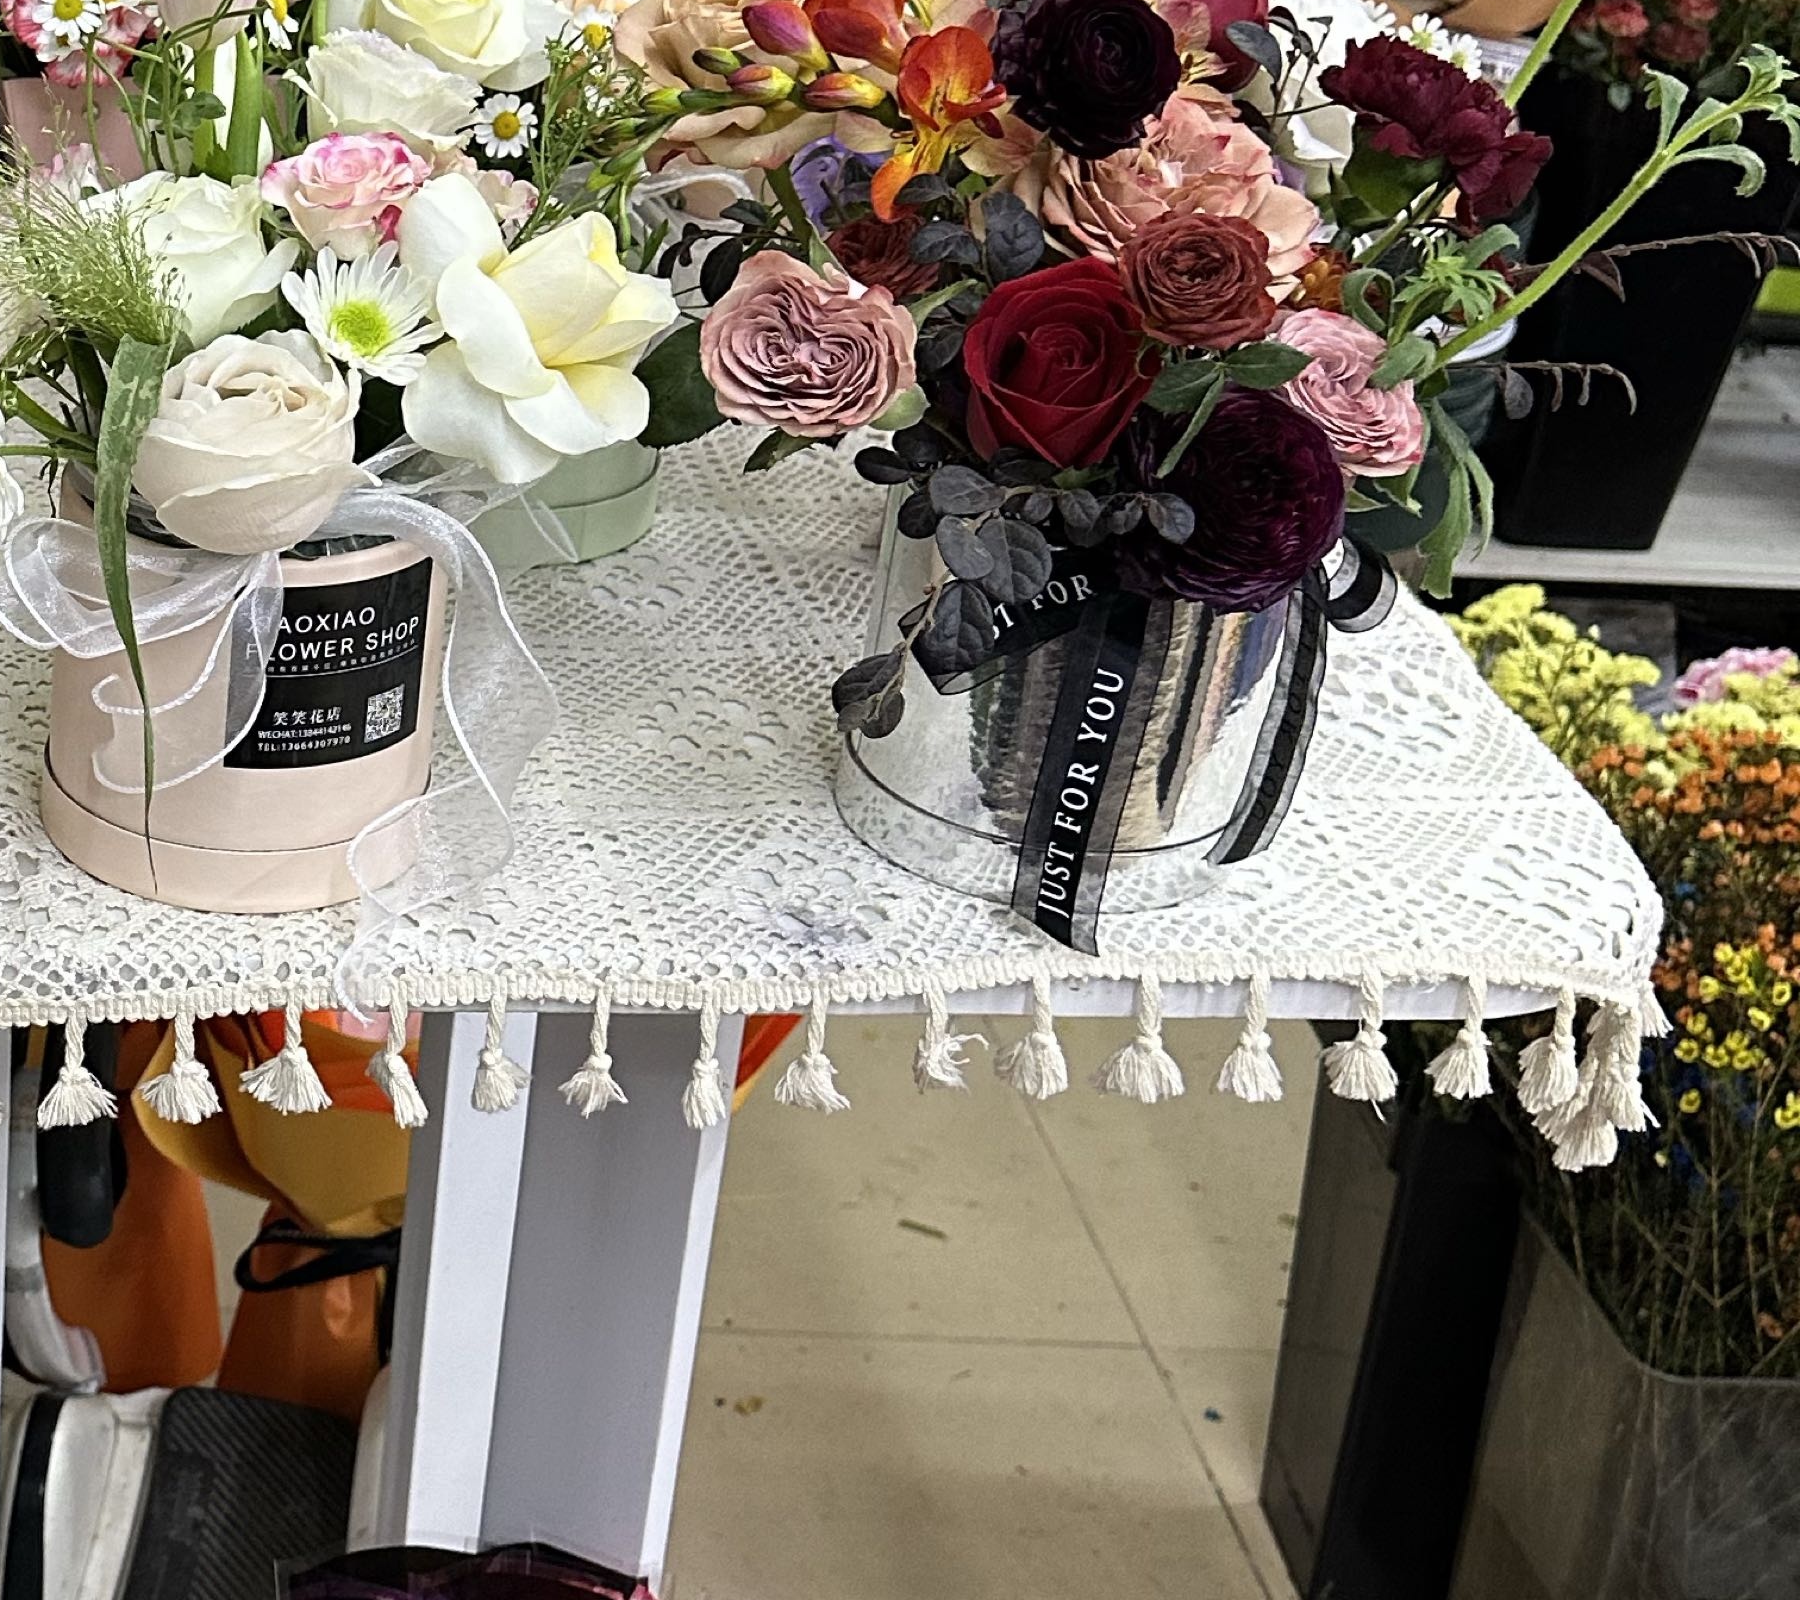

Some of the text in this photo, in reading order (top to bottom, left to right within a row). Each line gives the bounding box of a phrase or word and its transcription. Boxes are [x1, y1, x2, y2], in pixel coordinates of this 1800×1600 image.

[365, 616, 419, 651] SHOP
[1038, 668, 1125, 919] JUST FOR YOU
